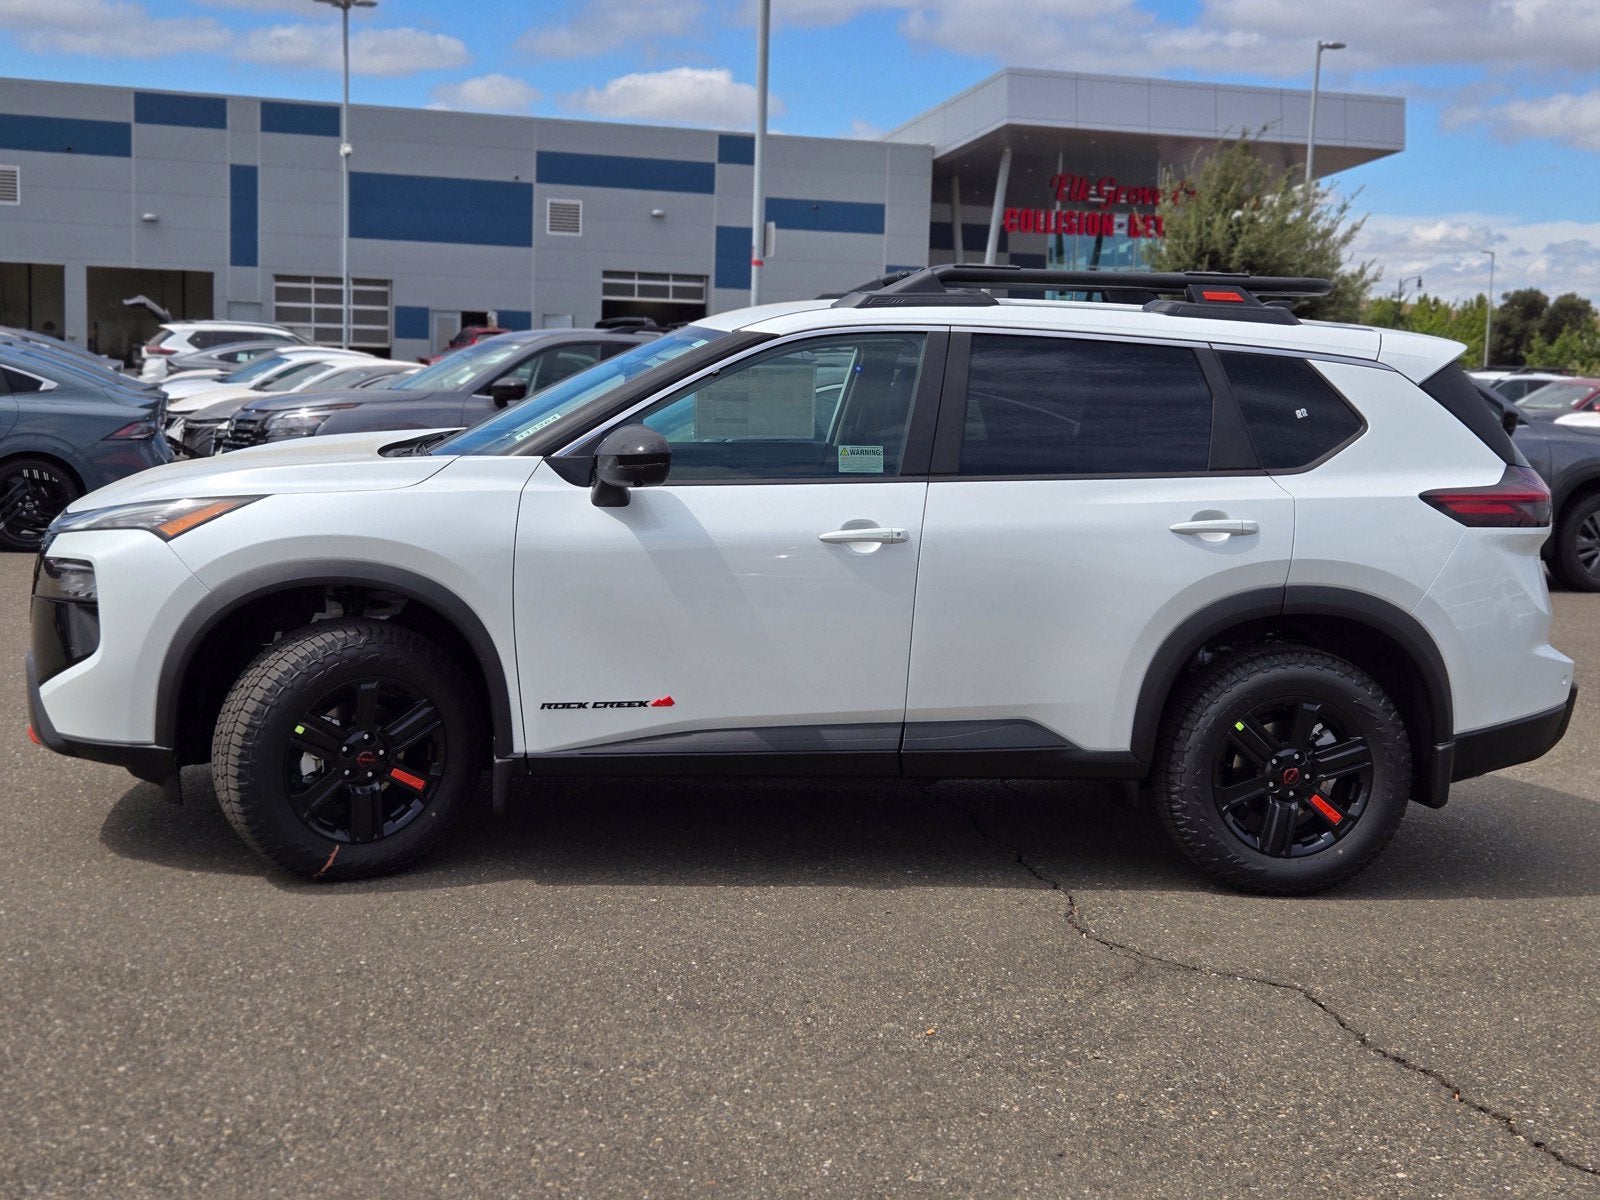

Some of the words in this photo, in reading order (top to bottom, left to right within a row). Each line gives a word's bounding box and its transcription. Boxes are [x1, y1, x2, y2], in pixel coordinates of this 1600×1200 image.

[1050, 173, 1091, 202] Elk
[1003, 207, 1115, 237] COLLISION
[540, 701, 590, 710] ROCK
[592, 700, 650, 709] CREEK
